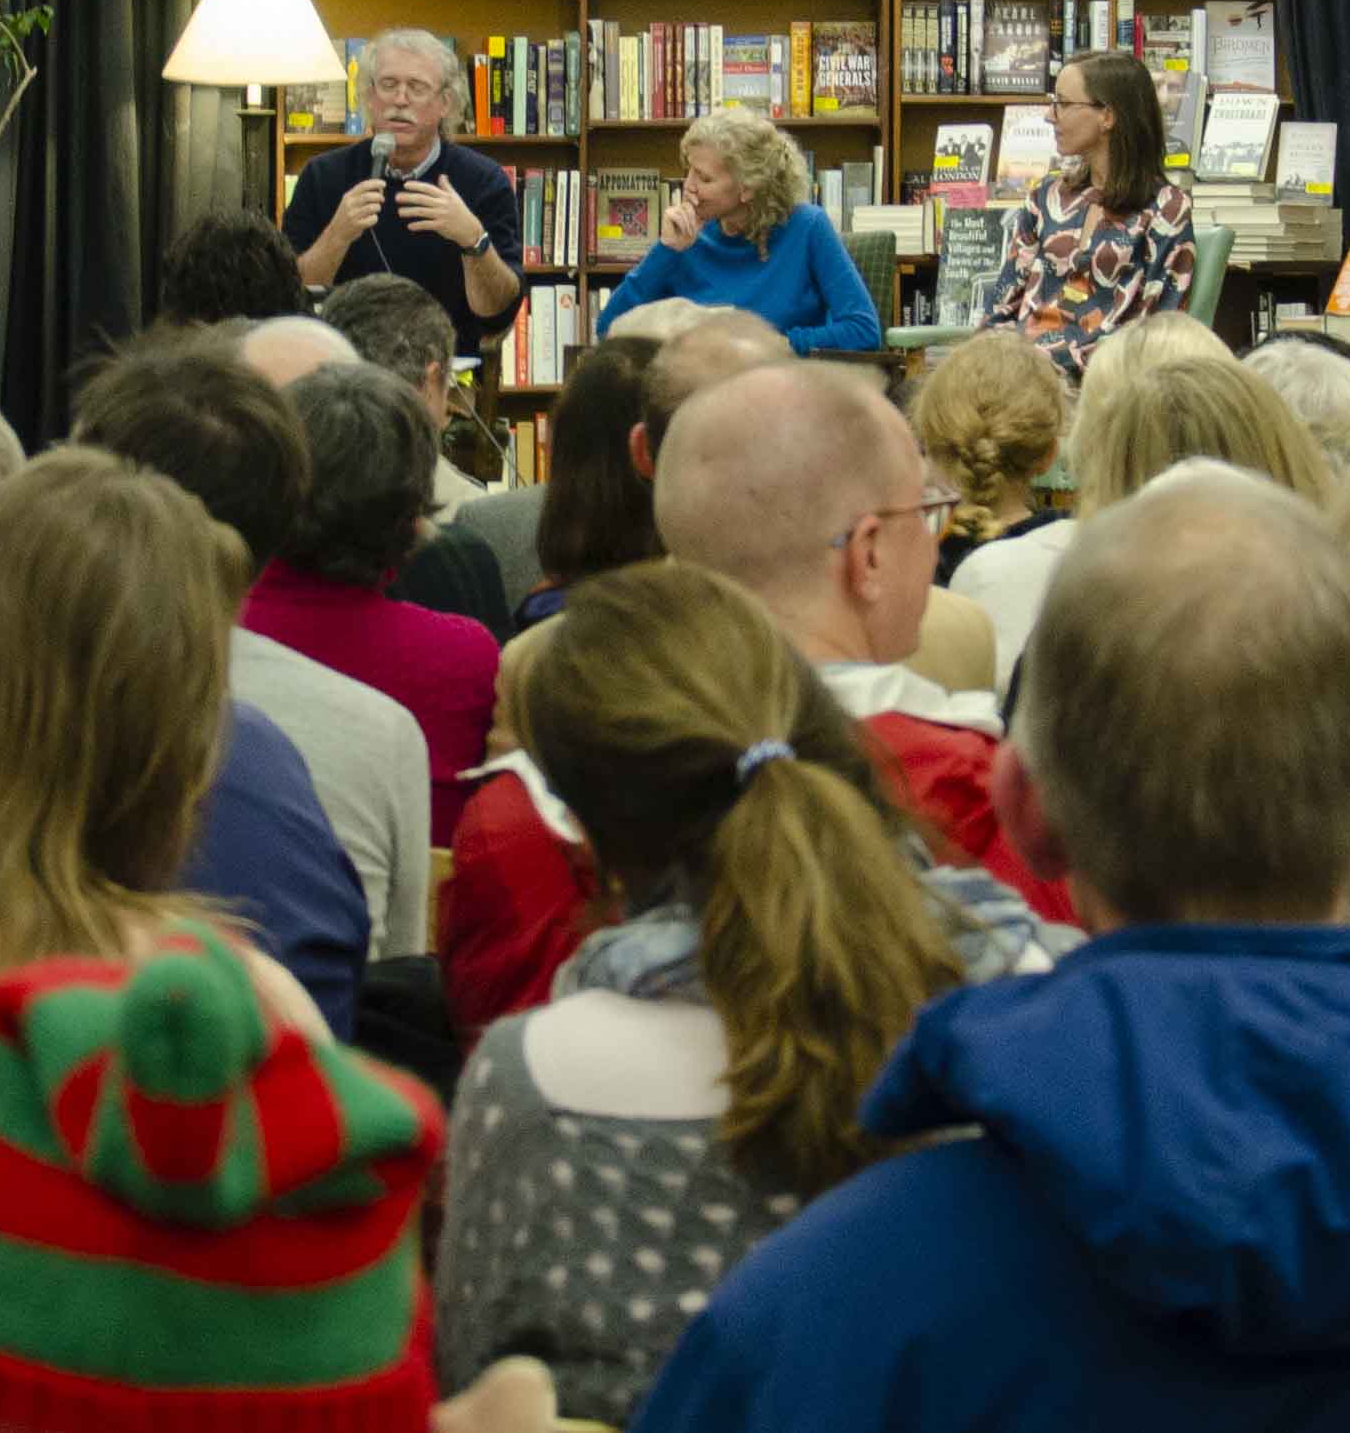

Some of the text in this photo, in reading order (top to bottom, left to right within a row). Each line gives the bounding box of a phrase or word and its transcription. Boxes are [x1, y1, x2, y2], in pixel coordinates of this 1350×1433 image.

[819, 54, 872, 70] CIVIL WAR
[818, 70, 872, 87] GENERALS
